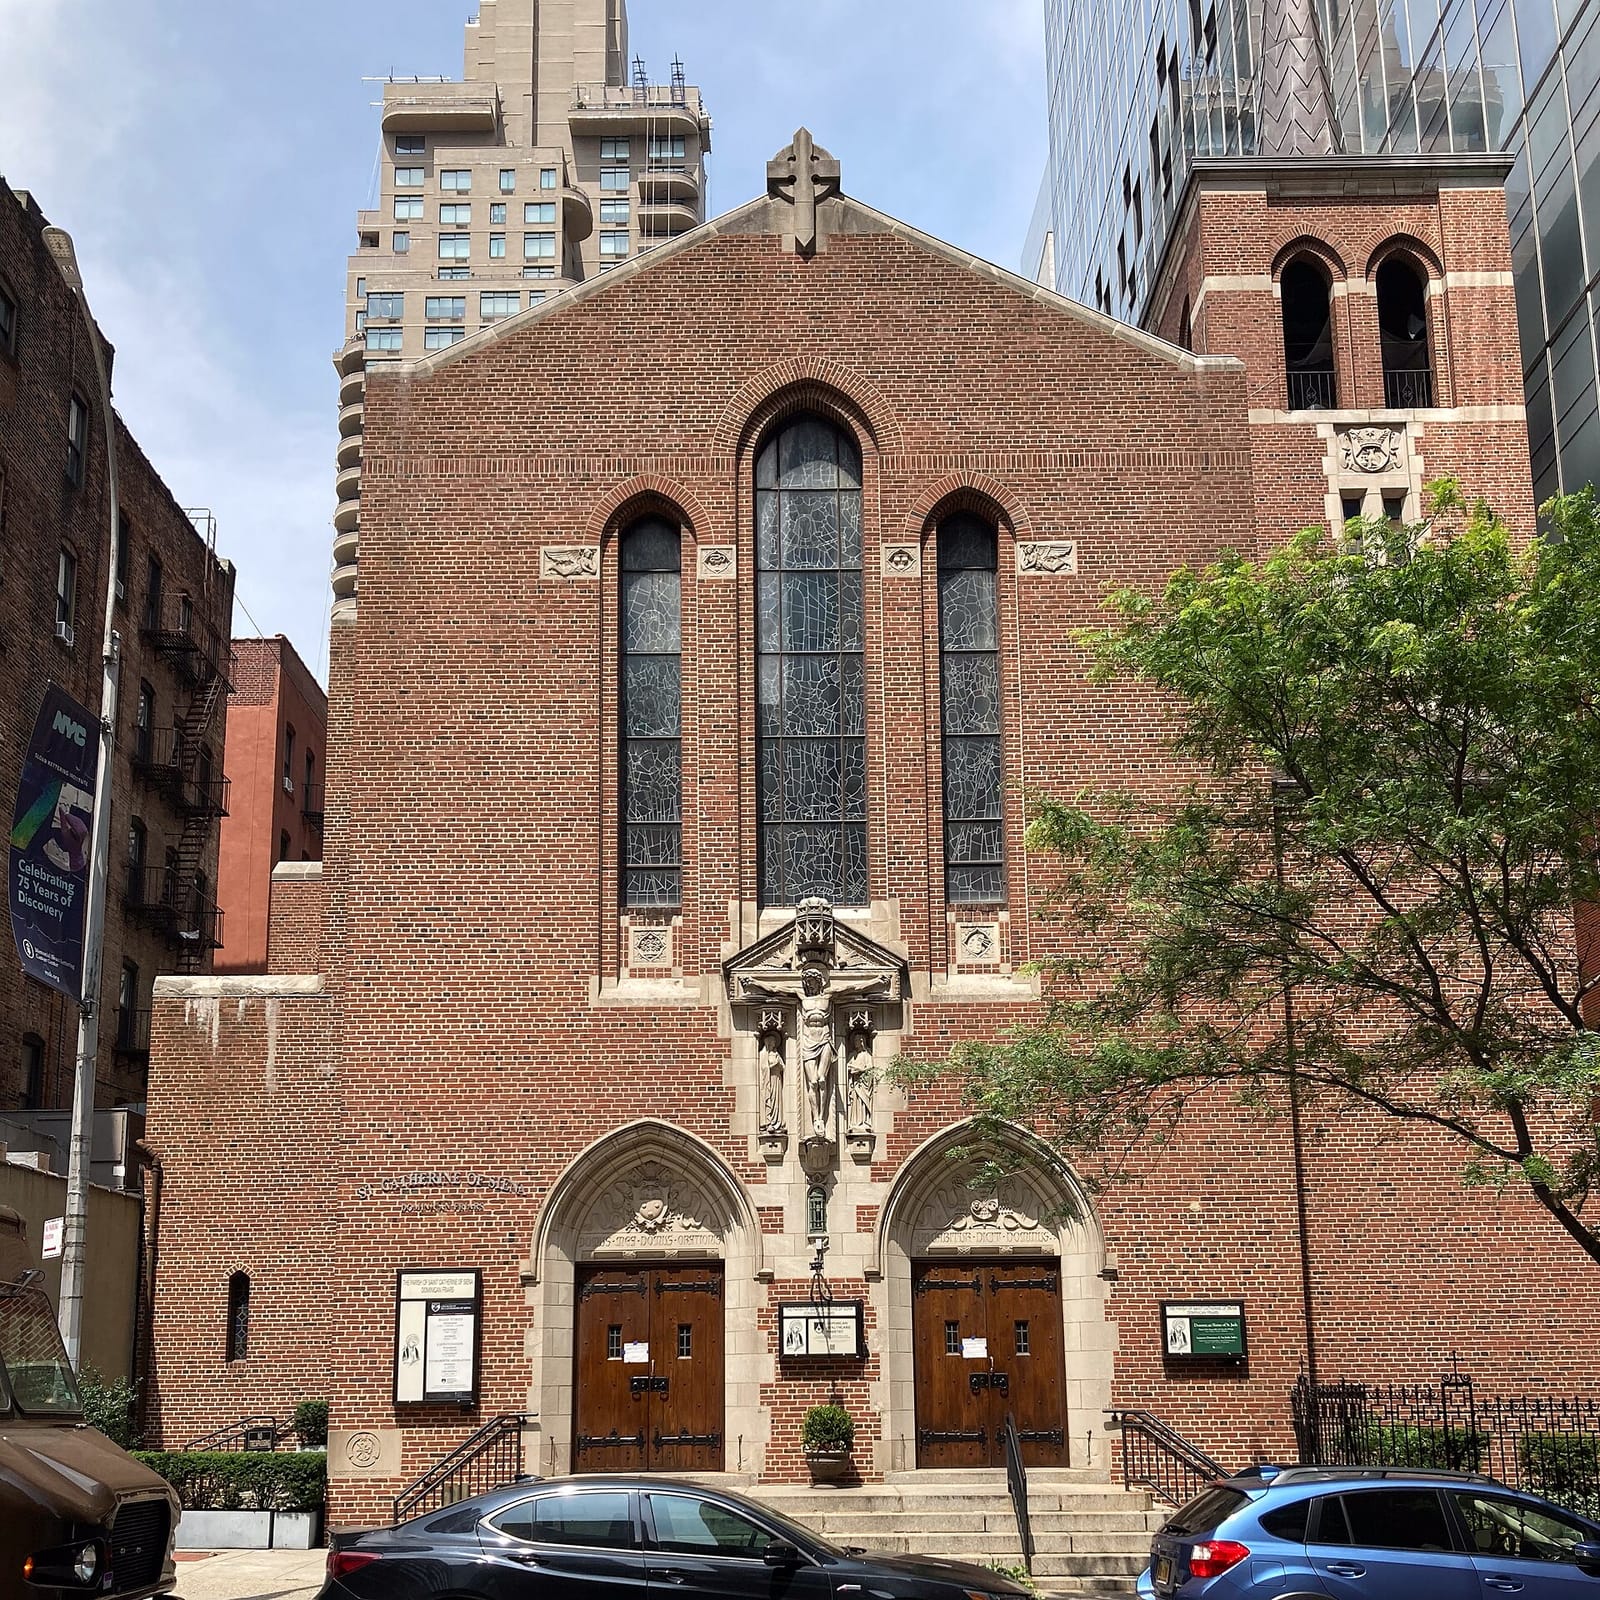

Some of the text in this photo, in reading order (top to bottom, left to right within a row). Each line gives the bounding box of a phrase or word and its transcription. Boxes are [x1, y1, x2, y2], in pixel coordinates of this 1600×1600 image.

[52, 710, 87, 747] NYC
[17, 874, 73, 908] 75 Years of
[18, 858, 75, 895] Celebrating
[18, 890, 64, 923] Discovery
[381, 1172, 462, 1193] CATHERINE
[467, 1173, 484, 1188] OF
[488, 1177, 527, 1197] SIENA
